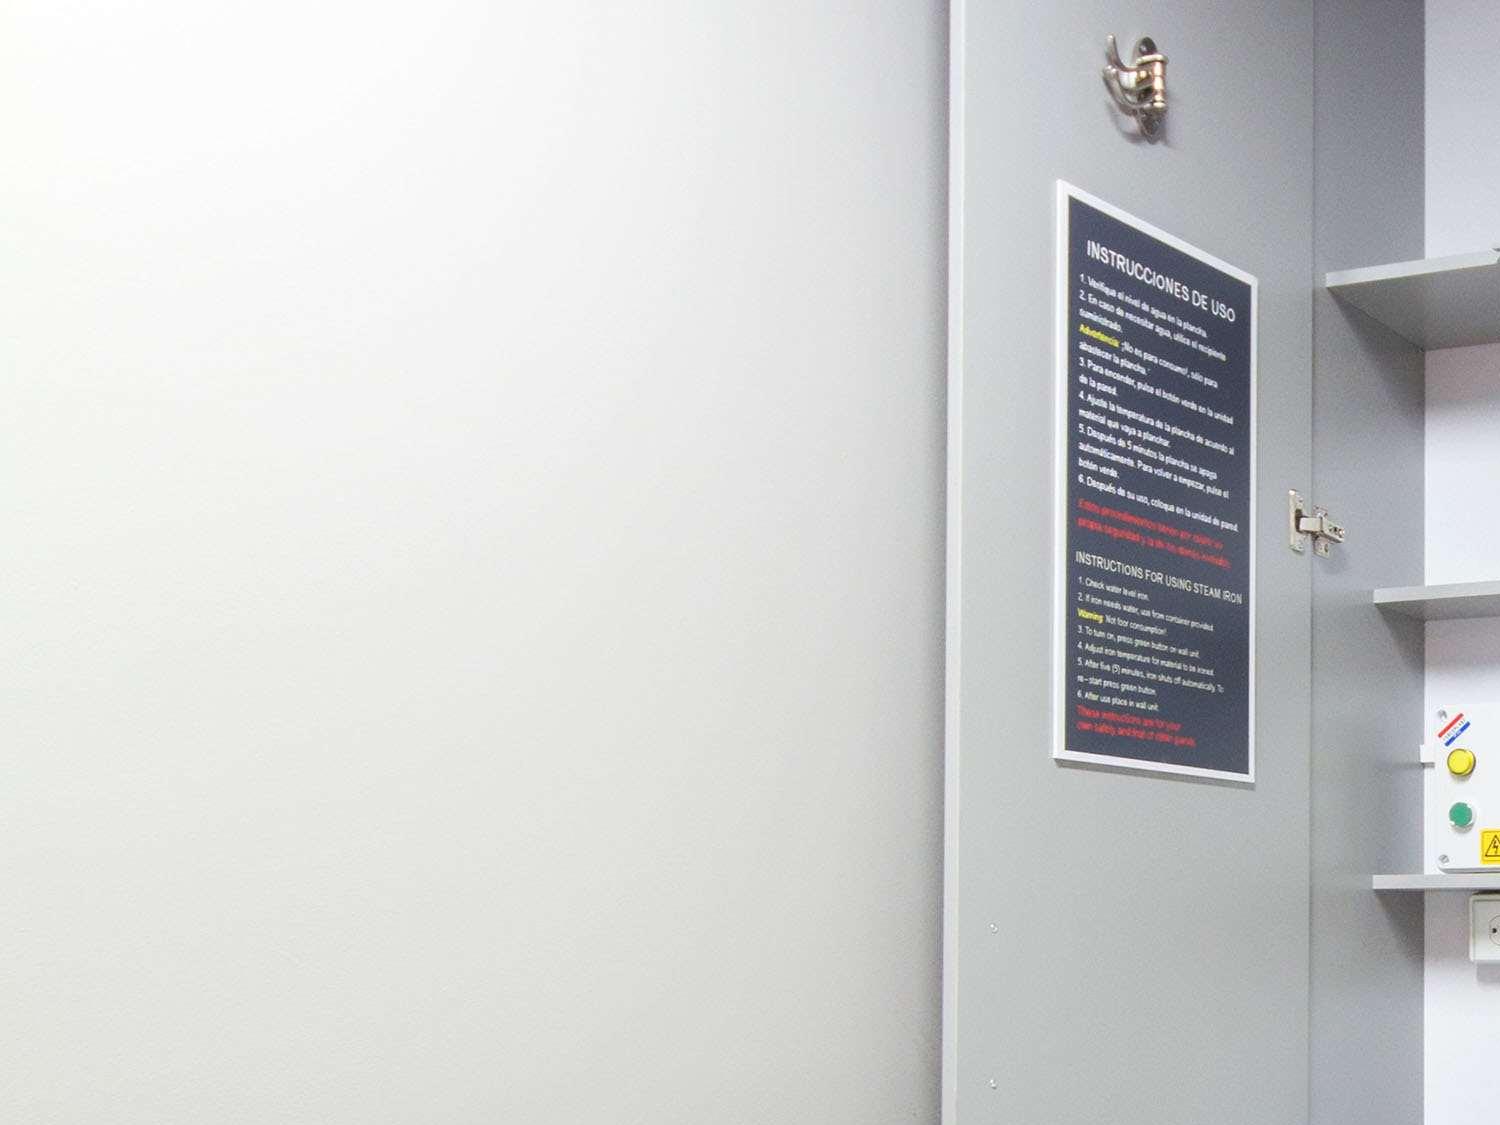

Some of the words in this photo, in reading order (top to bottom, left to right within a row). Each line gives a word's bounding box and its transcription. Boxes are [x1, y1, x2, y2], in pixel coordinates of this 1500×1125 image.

[1087, 240, 1190, 301] INSTRUCCIONES
[1192, 290, 1208, 311] DE
[1211, 299, 1236, 322] USO
[1076, 551, 1143, 579] INSTRUCTIONS
[1145, 569, 1163, 584] FOR
[1165, 575, 1192, 592] USING
[1193, 582, 1221, 599] STEAM
[1222, 590, 1242, 604] IRON
